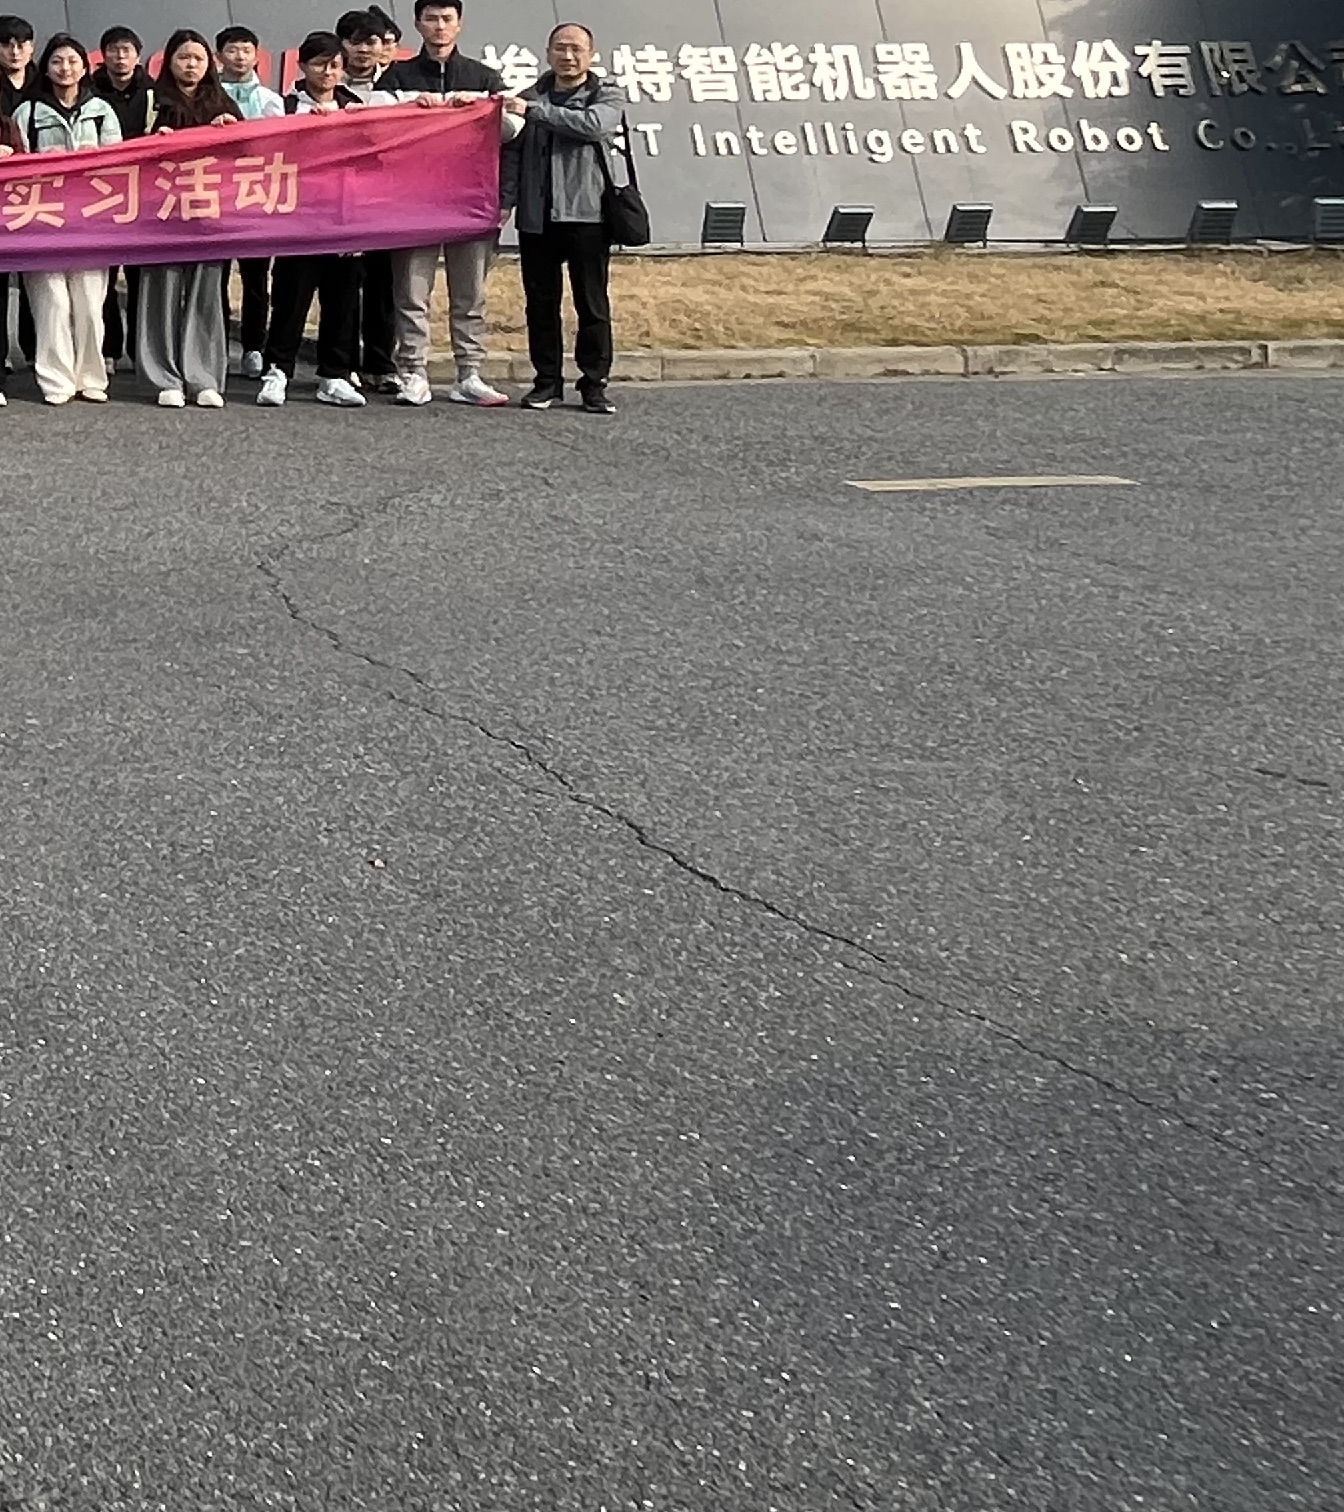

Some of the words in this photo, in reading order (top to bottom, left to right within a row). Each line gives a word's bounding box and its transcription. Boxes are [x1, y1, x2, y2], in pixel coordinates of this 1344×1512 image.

[481, 39, 1344, 102] 埃特智能机器人股份有限公
[693, 121, 988, 163] Intelligent
[1013, 117, 1170, 156] Robot
